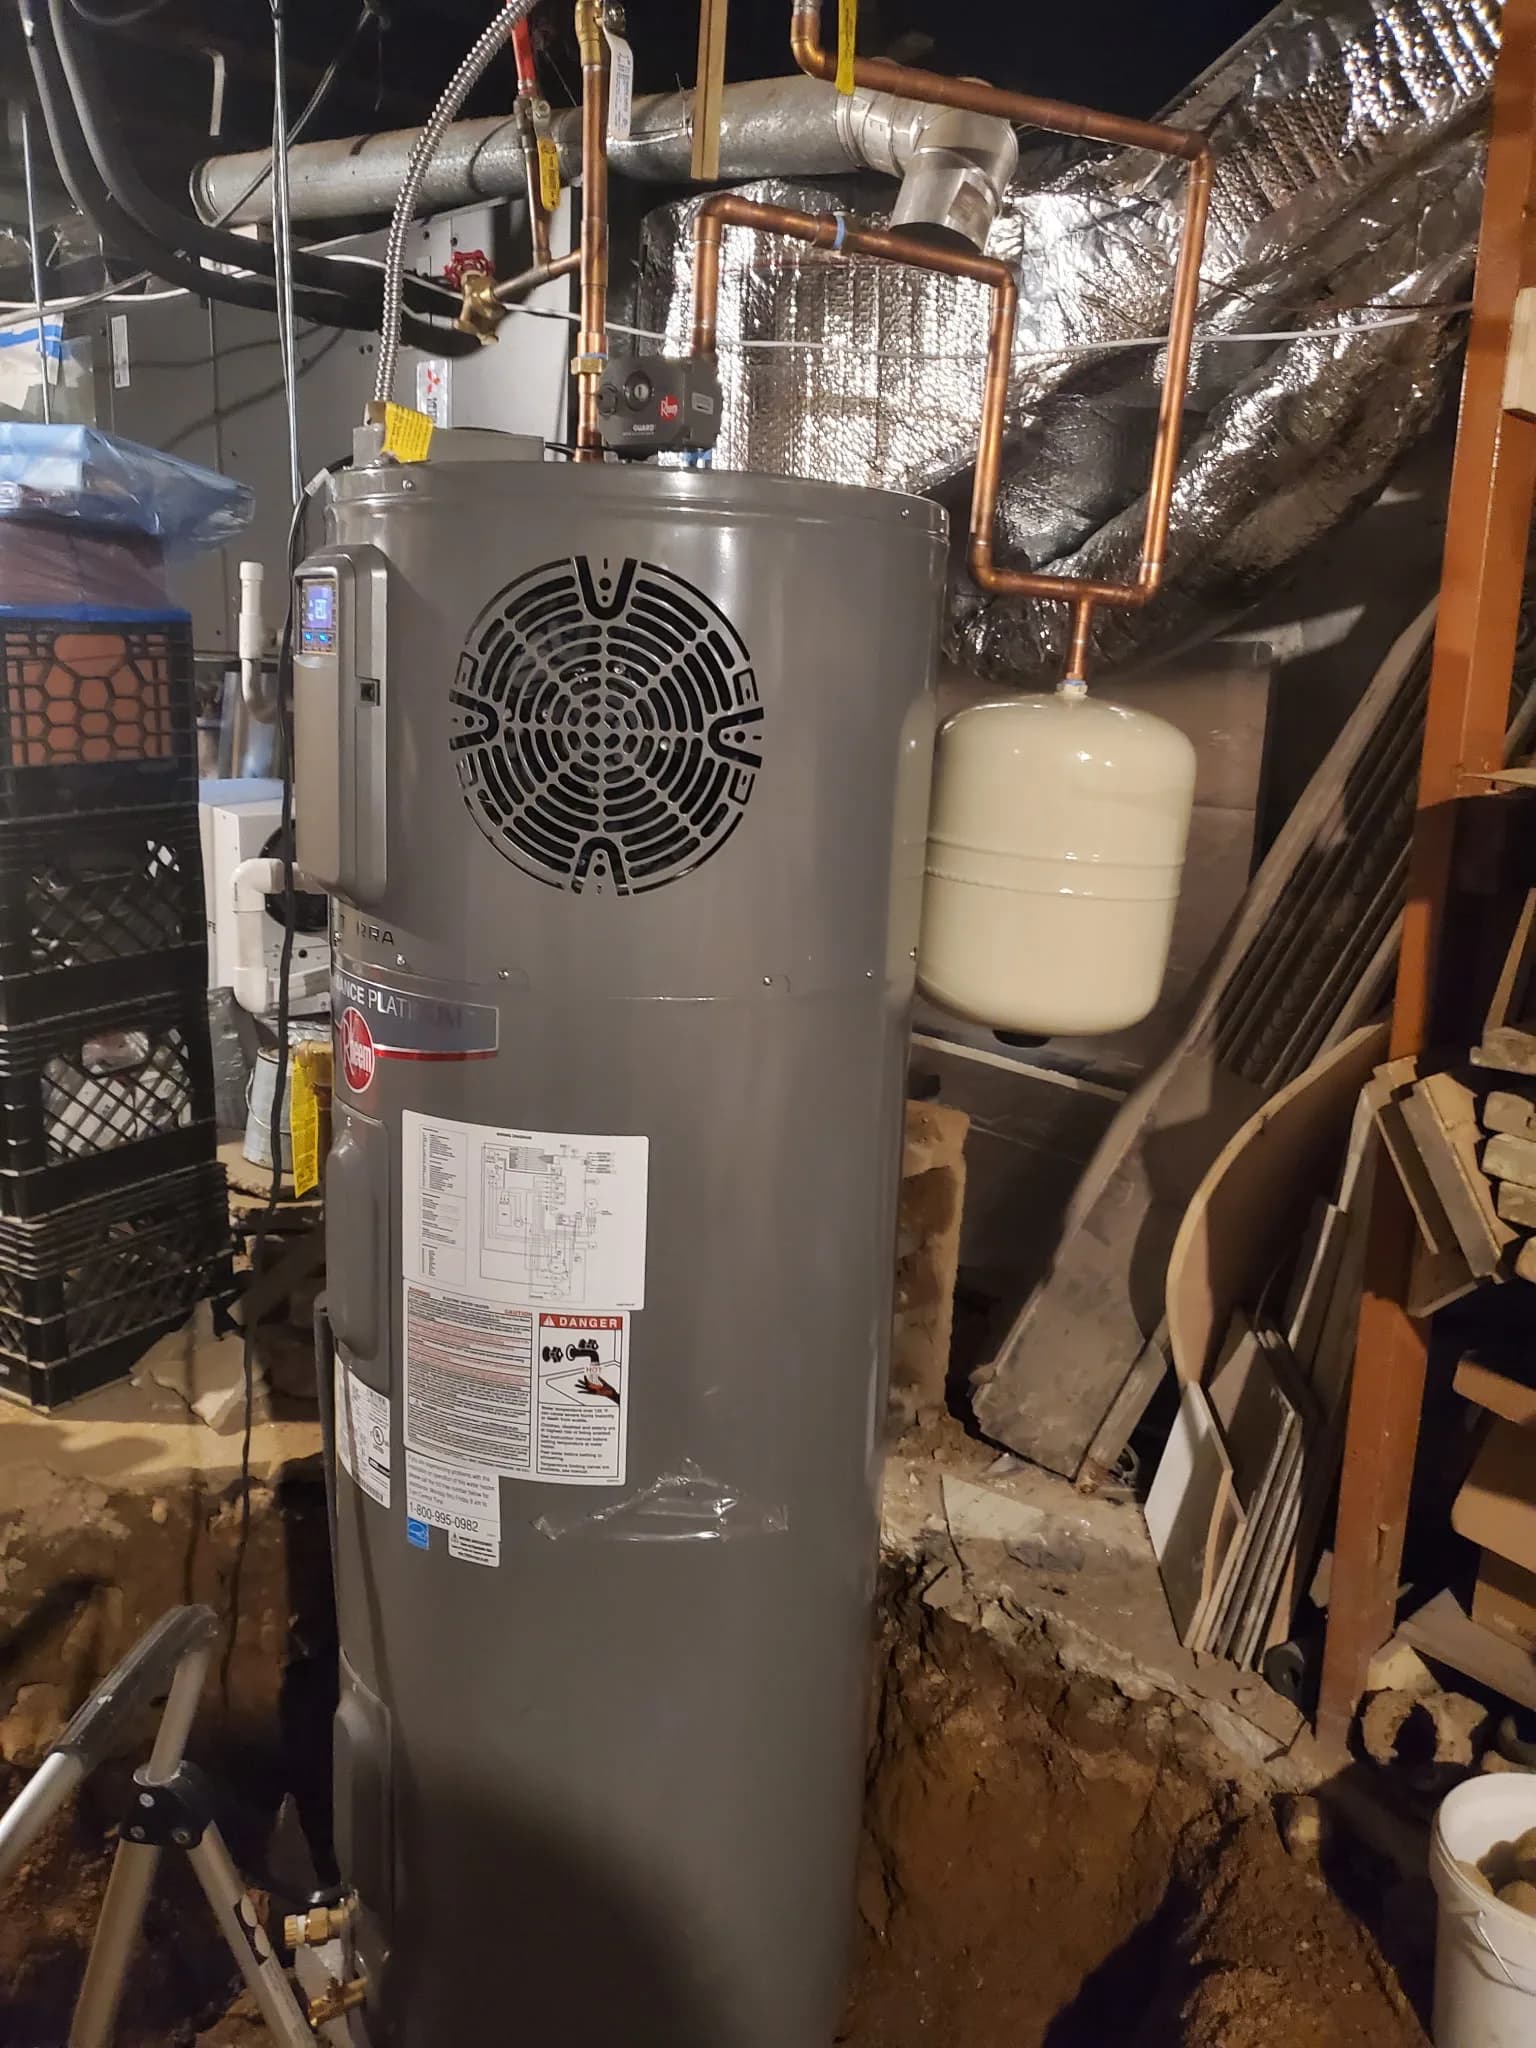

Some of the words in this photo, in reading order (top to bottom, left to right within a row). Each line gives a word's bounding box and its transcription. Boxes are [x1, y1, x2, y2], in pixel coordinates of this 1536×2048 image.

[342, 1008, 372, 1077] Rheem
[559, 1316, 618, 1329] DANGER
[409, 1501, 479, 1533] 1-800-995-0982
